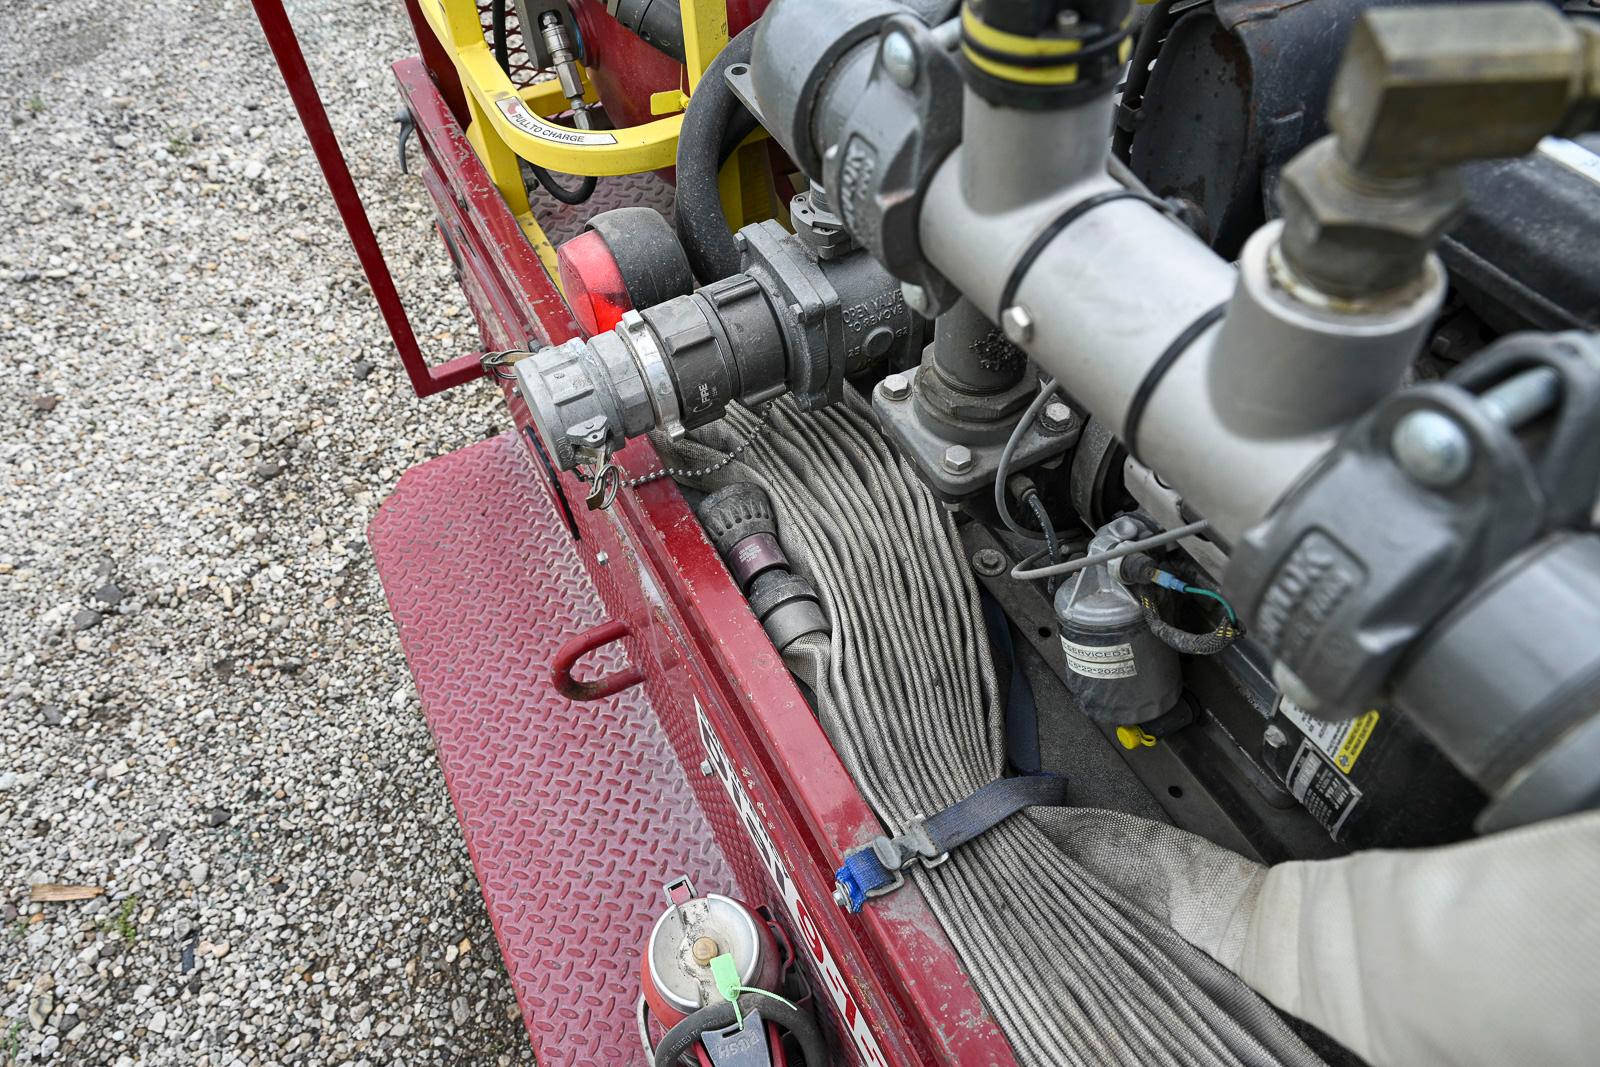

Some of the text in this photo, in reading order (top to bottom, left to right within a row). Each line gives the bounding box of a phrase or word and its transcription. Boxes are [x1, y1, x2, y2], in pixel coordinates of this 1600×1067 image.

[511, 113, 585, 143] PULL TO CHARGE
[842, 302, 868, 324] OPEN
[863, 303, 904, 329] REMOVE
[699, 716, 786, 896] Dial
[719, 1030, 760, 1059] PUSH
